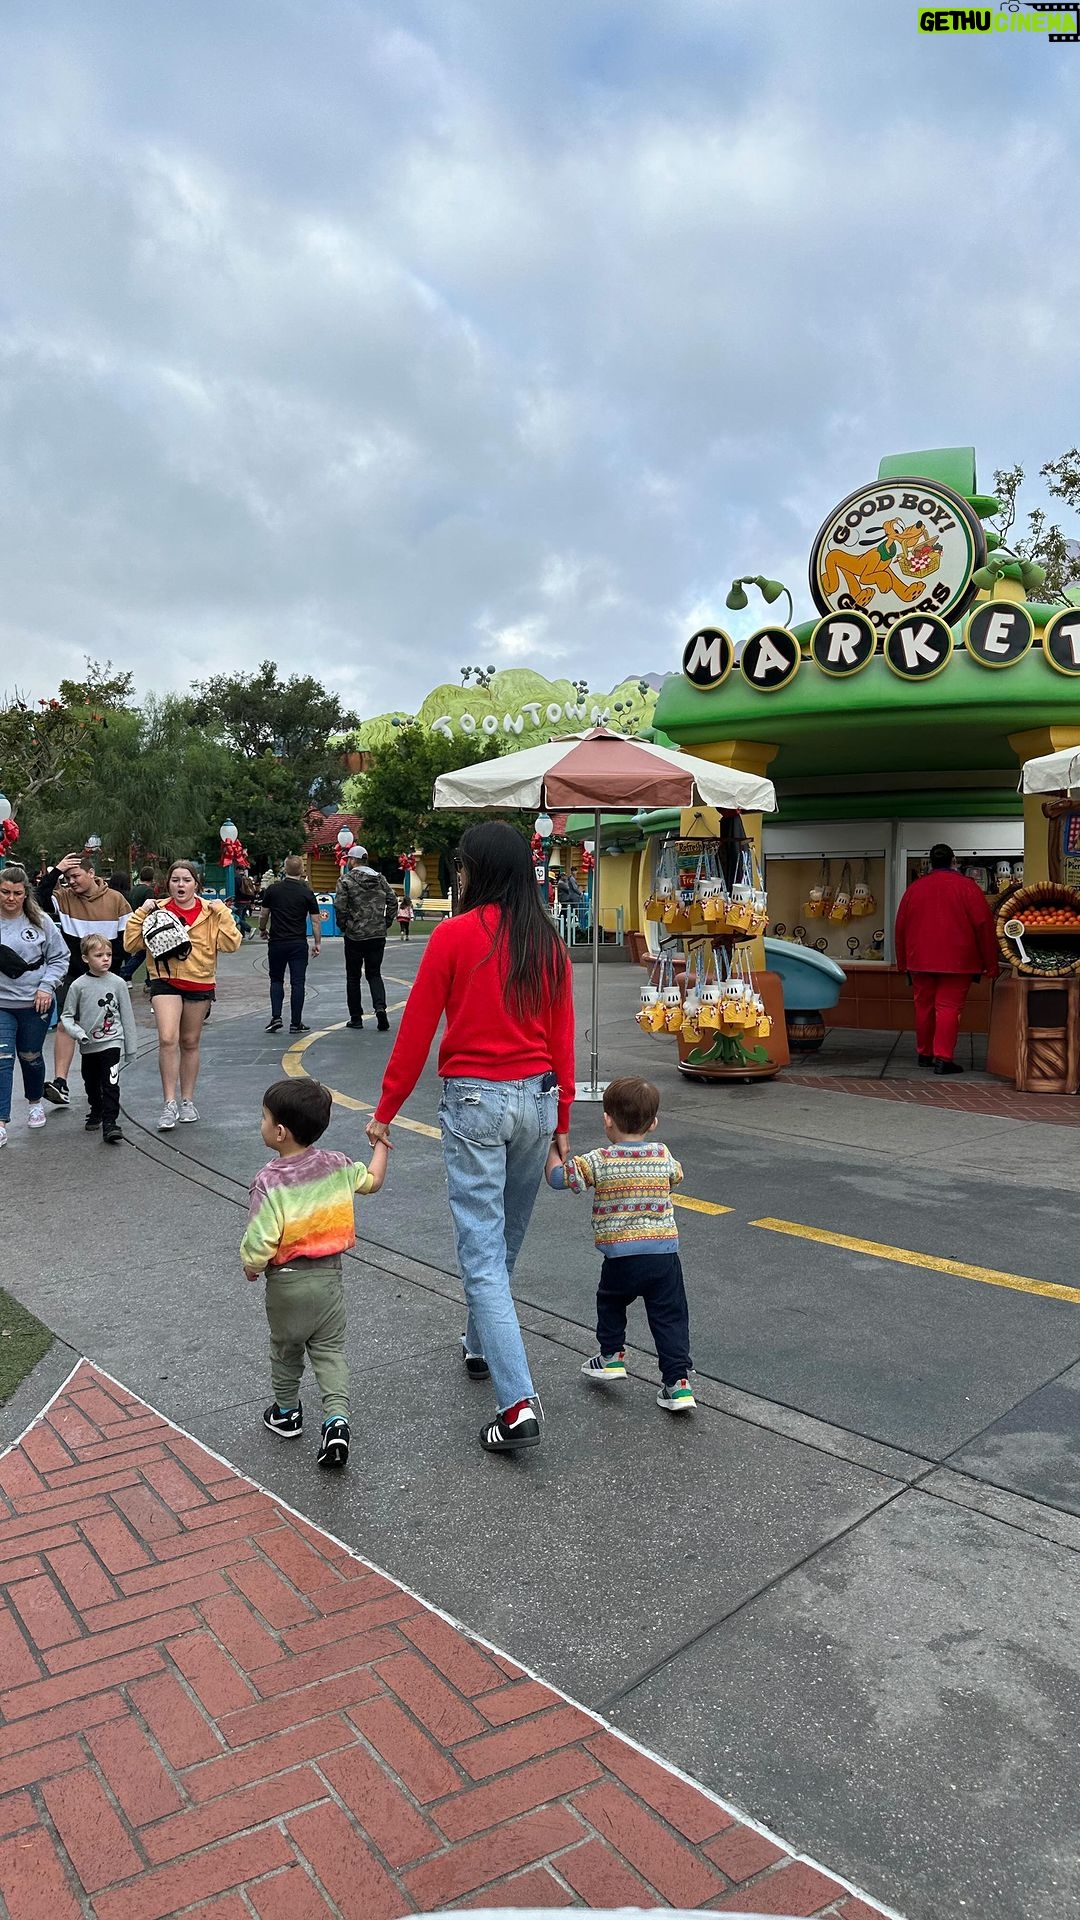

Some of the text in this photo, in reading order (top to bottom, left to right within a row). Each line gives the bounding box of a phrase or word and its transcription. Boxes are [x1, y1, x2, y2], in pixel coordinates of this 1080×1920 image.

[833, 493, 956, 544] GOOD BOY!
[432, 702, 610, 743] TOONTOWN
